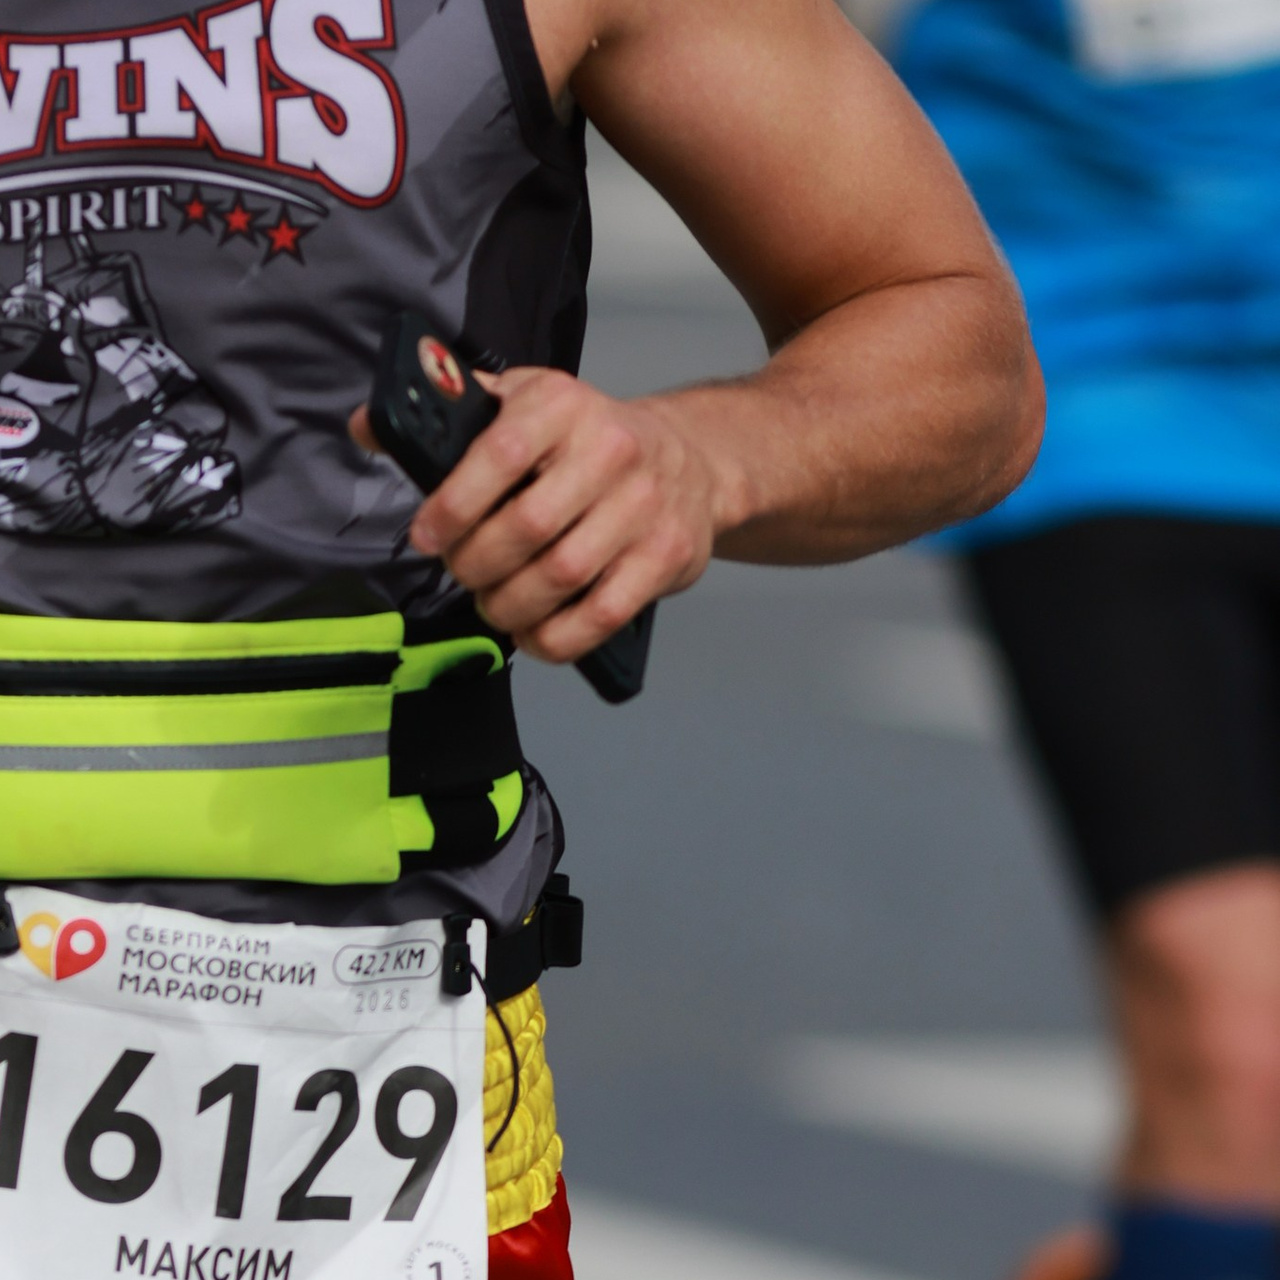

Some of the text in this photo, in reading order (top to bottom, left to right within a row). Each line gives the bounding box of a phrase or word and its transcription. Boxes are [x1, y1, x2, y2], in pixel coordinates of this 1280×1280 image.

[125, 924, 271, 955] СБЕРПРАЙМ
[121, 947, 317, 986] МОСКОВСКИЙ
[117, 972, 263, 1007] МАРАФОН
